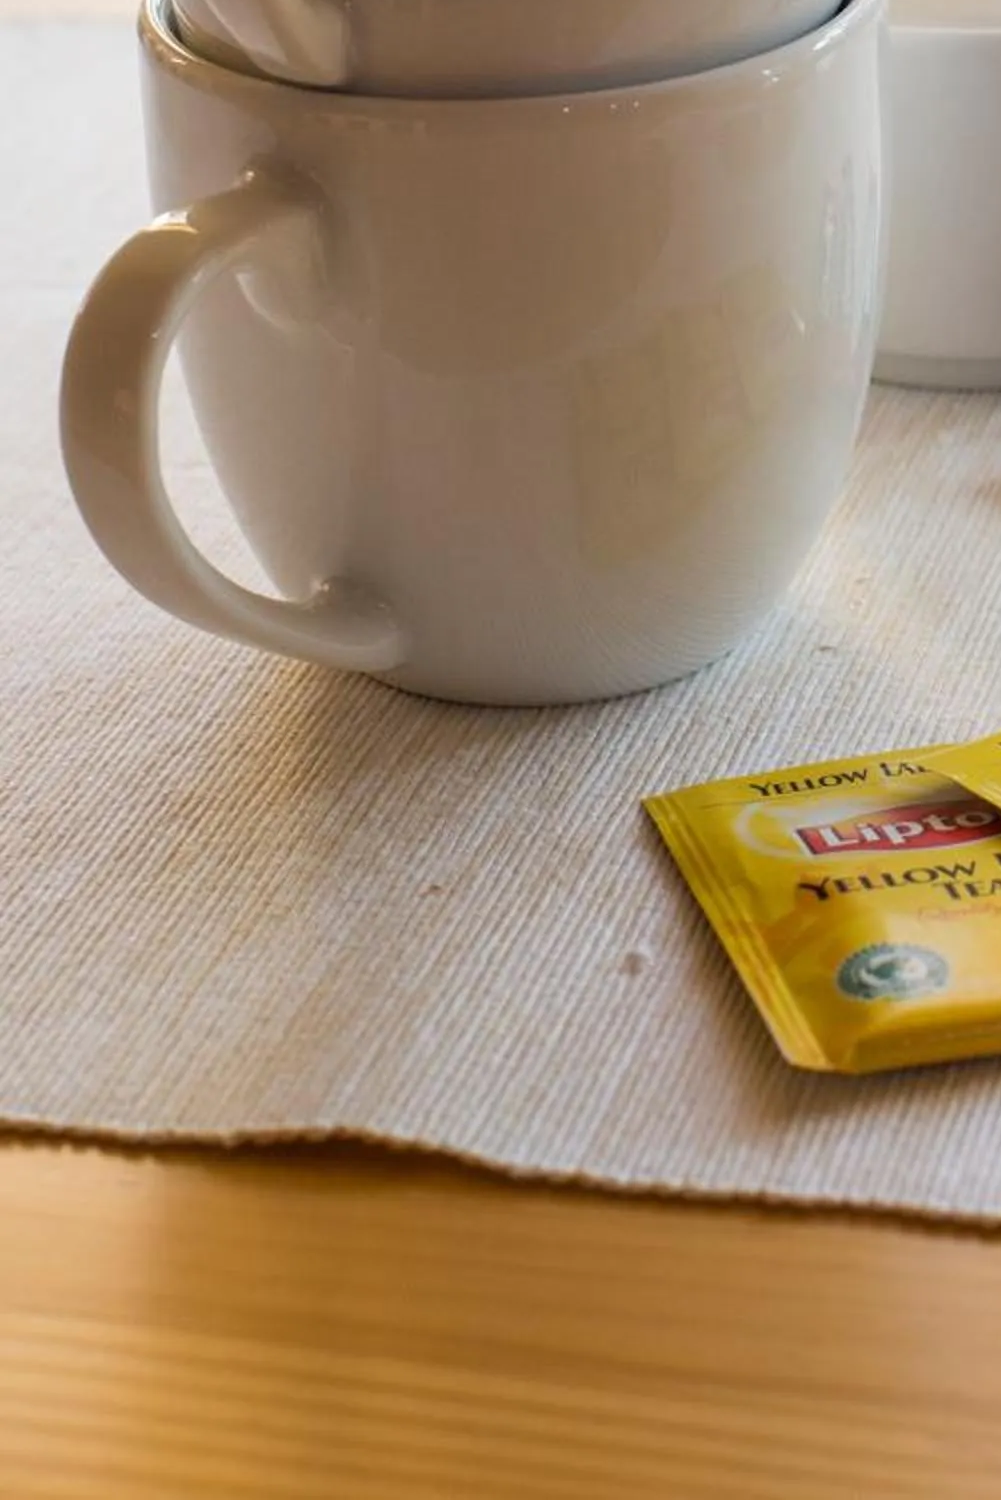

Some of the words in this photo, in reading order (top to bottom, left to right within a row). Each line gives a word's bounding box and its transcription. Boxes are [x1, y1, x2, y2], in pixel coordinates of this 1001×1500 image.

[750, 767, 869, 797] YELLOW
[821, 810, 996, 849] Lipto
[799, 861, 978, 902] YELLOW
